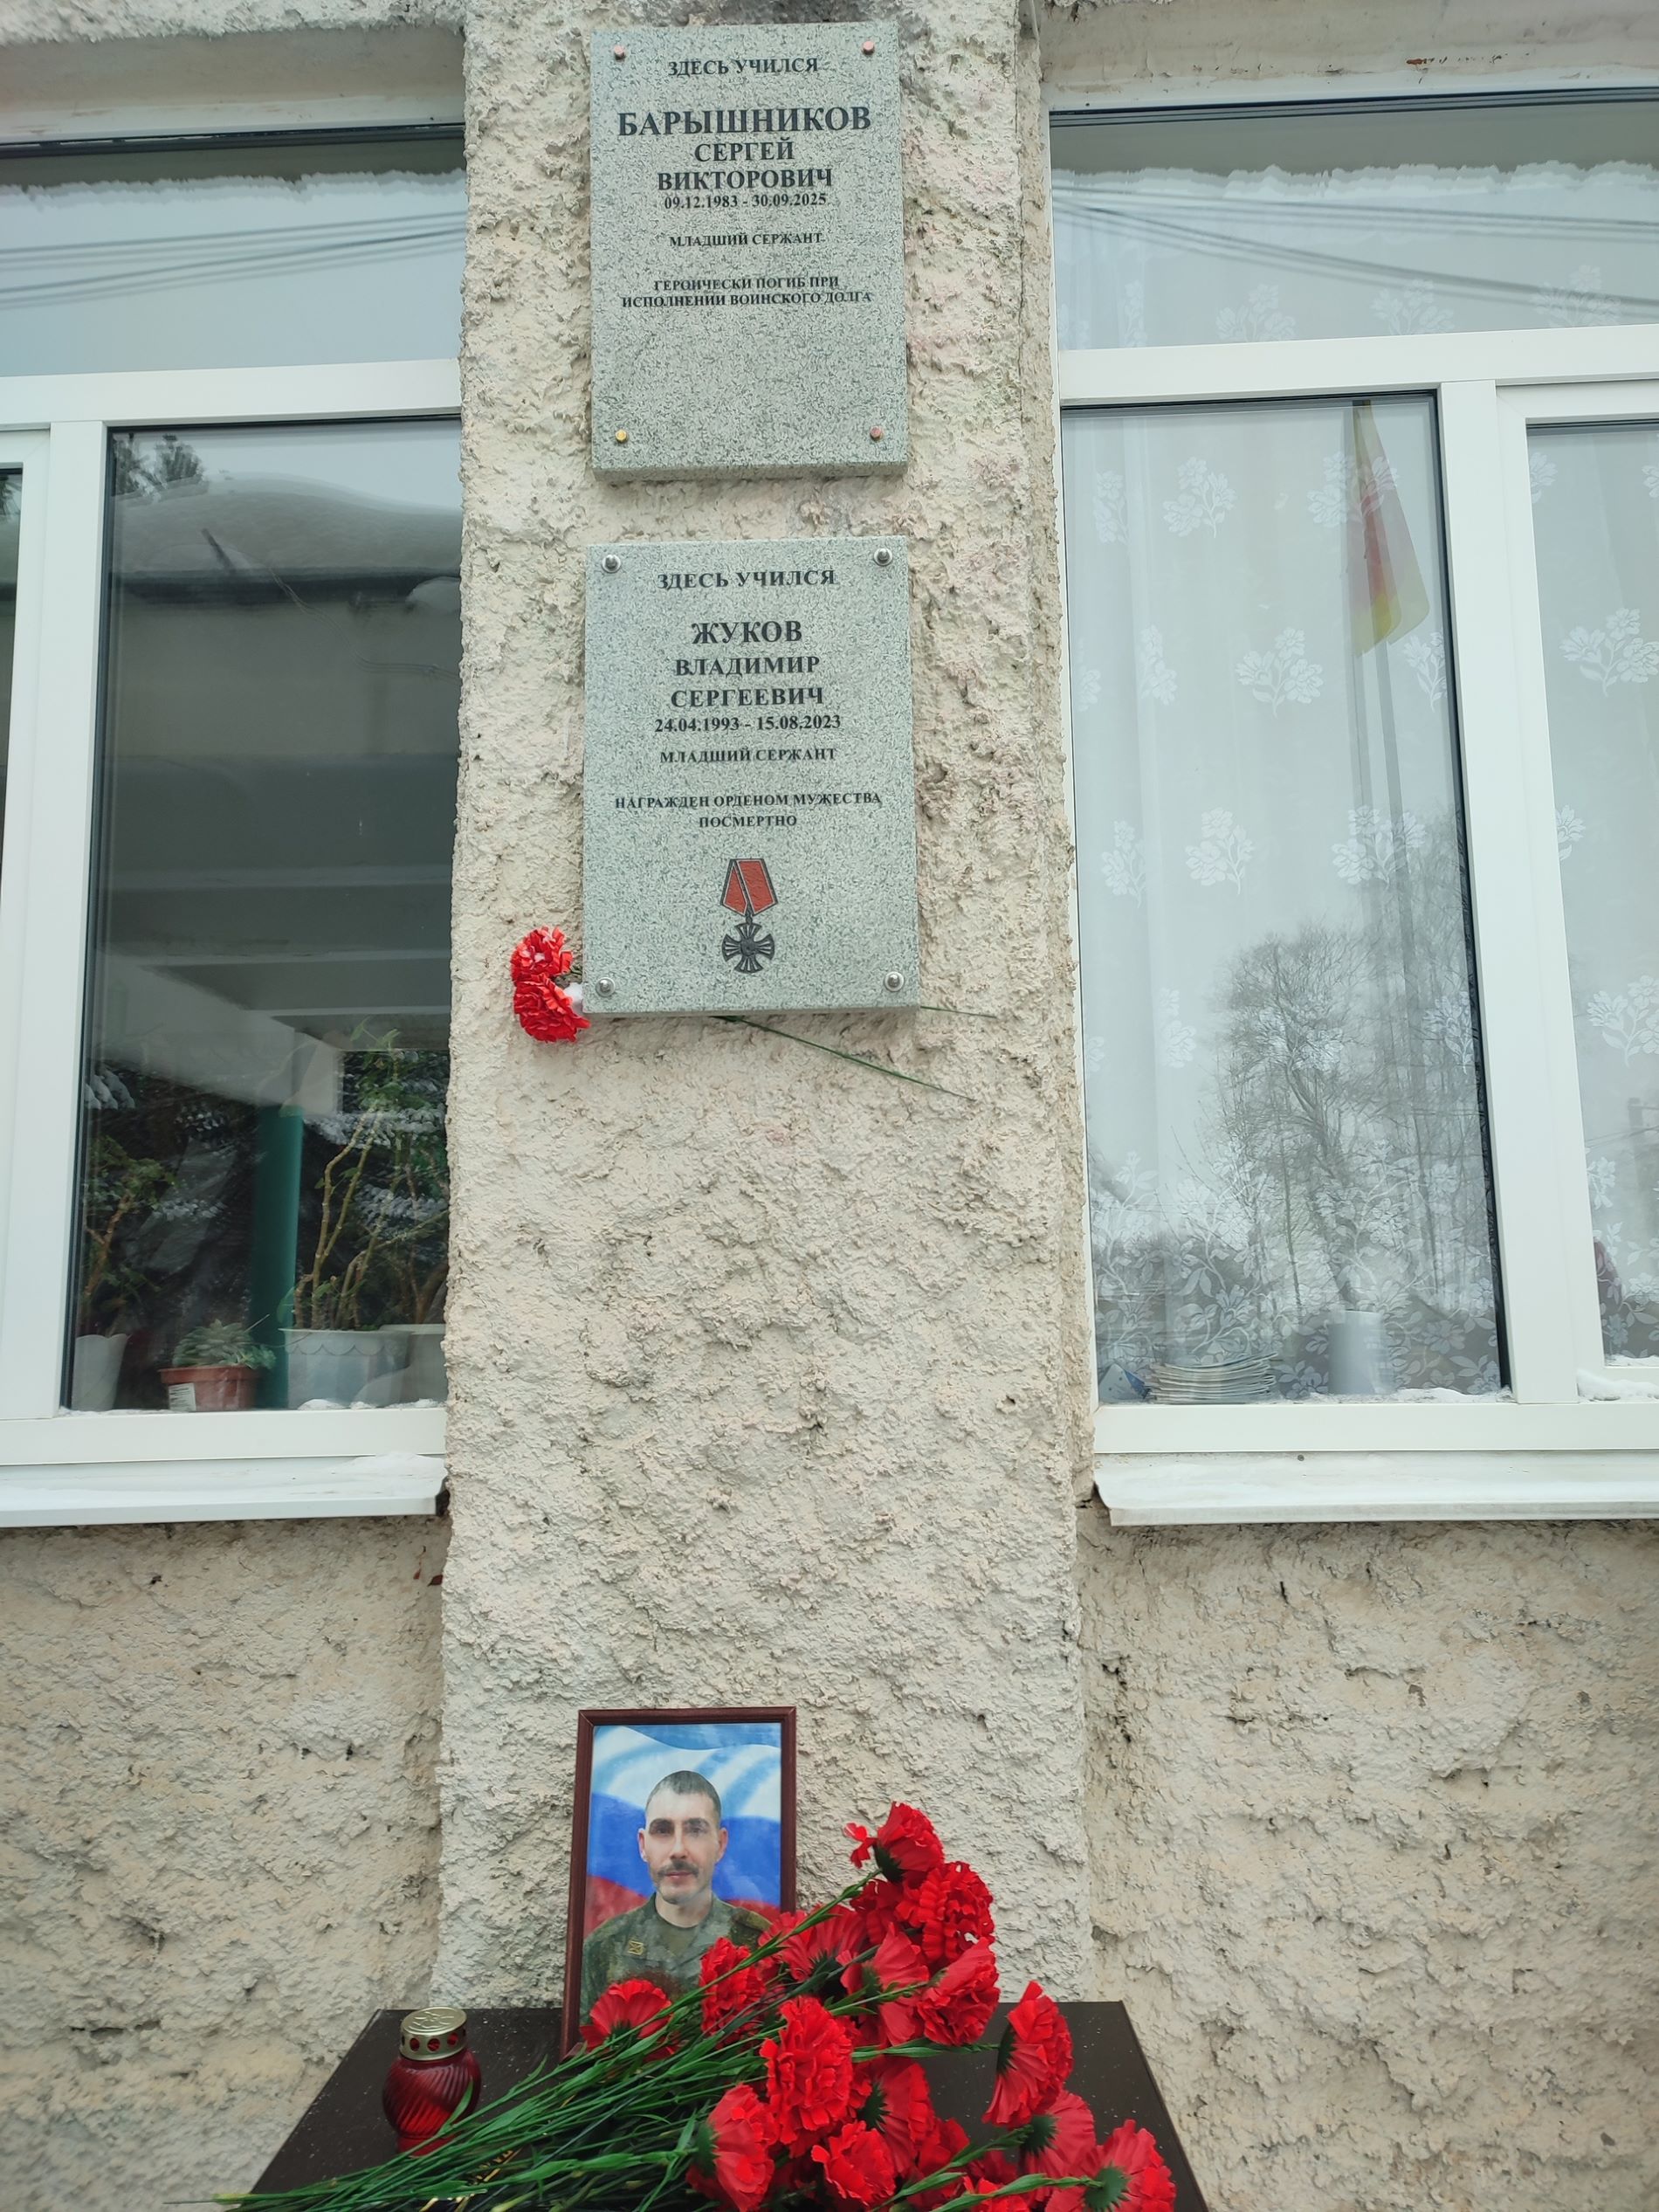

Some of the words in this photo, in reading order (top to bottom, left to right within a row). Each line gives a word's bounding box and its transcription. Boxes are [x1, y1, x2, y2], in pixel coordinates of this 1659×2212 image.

[668, 60, 728, 77] ЗДЕСЬ
[735, 58, 818, 74] УЧИЛСЯ
[617, 107, 871, 136] БАРЫШНИКОВ
[694, 138, 795, 162] СЕРГЕЙ
[657, 169, 831, 190] ВИКТОРОВИЧ
[664, 195, 739, 210] 09.12.1983
[751, 193, 827, 208] 30.09.2025
[669, 232, 748, 247] МЛАДШИЙ
[752, 232, 823, 245] СЕРЖАНТ
[654, 279, 752, 292] ГЕРОИЧЕСКИ
[756, 278, 805, 289] ПОГИБ
[809, 277, 839, 288] ПРИ
[623, 295, 726, 308] ИСПОЛНЕНИИ
[731, 293, 821, 306] ВОИНСКОГО
[825, 292, 871, 305] ДОЛГА
[657, 572, 729, 589] ЗДЕСЬ
[738, 570, 835, 587] УЧИЛСЯ
[692, 621, 802, 644] ЖУКОВ
[675, 657, 820, 677] ВЛАДИМИР
[671, 687, 823, 707] СЕРГЕЕВИЧ
[654, 717, 740, 733] 24.04.1993
[757, 714, 841, 731] 15.08.2023
[659, 747, 751, 763] МЛАДШИЙ
[755, 748, 836, 761] СЕРЖАНТ
[615, 796, 710, 809] НАГРАЖДЕН
[714, 795, 788, 809] ОРДЕНОМ
[793, 792, 882, 806] МУЖЕСТВА
[699, 815, 797, 828] ПОСМЕРТНО
